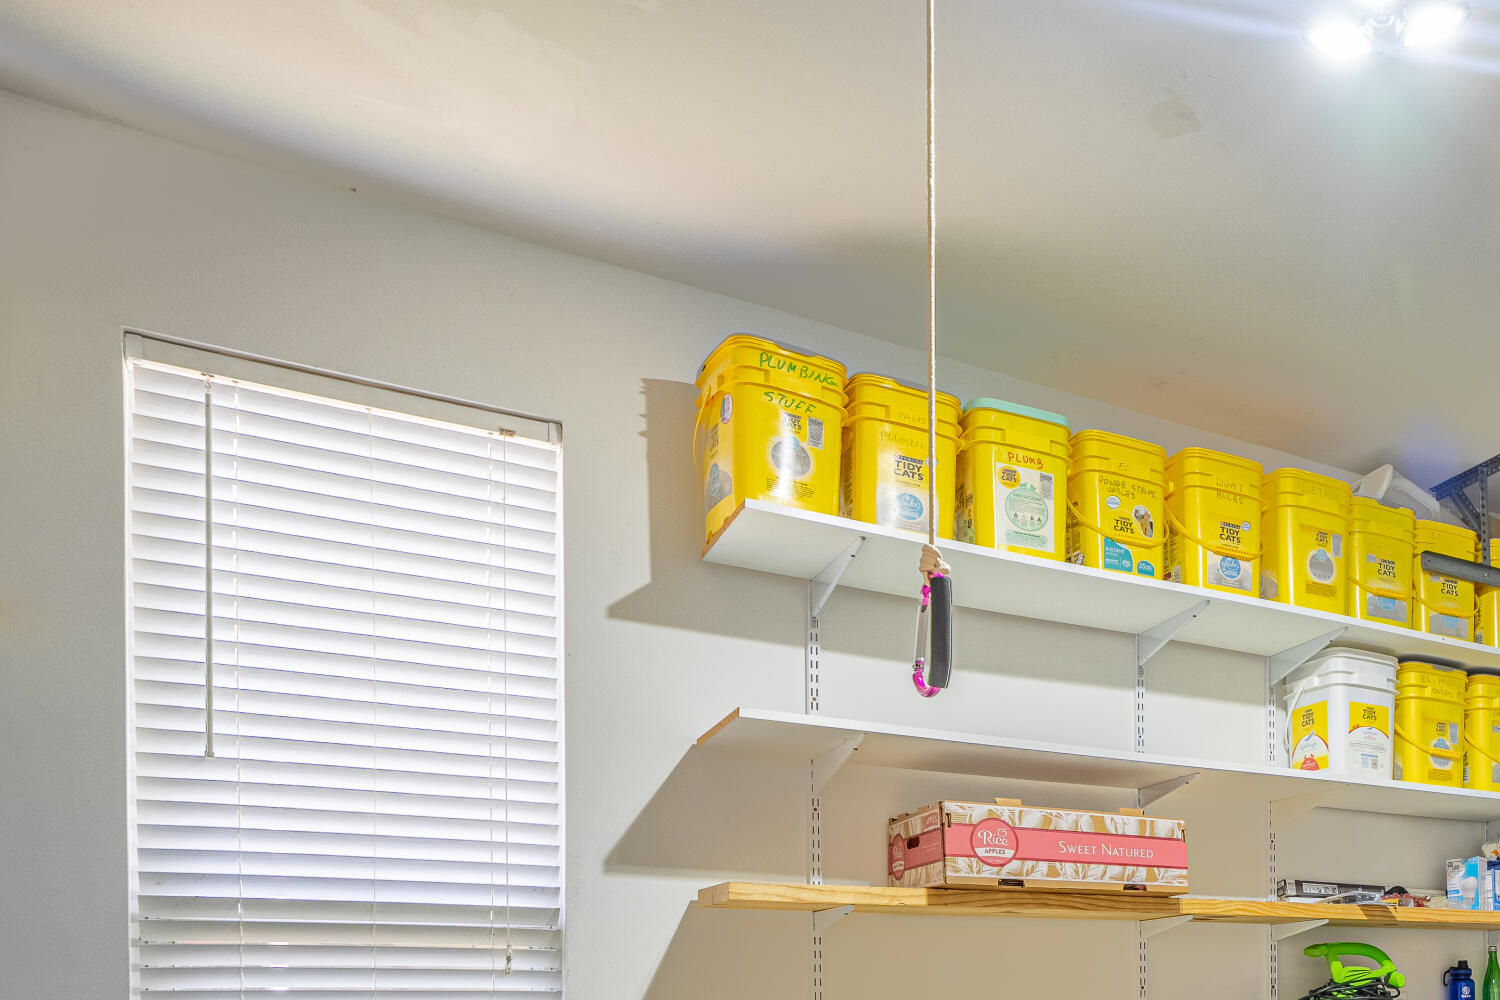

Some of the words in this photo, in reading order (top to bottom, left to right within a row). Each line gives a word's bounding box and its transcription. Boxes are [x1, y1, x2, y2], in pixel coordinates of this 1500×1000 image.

[760, 352, 838, 387] PLUMBING
[764, 391, 816, 413] STUFF
[1007, 451, 1044, 469] PLUMB
[895, 460, 923, 473] TIDY
[894, 468, 924, 481] CATS
[1001, 475, 1018, 483] CATS
[1002, 471, 1017, 479] TIDY
[1115, 519, 1133, 527] TIDY
[1113, 526, 1135, 535] CATS
[1220, 526, 1240, 536] TIDY
[1219, 533, 1241, 544] CATS
[1378, 563, 1395, 571] TIDY
[1377, 568, 1396, 578] CATS
[1442, 582, 1457, 590] TIDY
[1441, 588, 1459, 597] CATS
[1301, 718, 1315, 727] CATS
[977, 829, 1009, 846] Rice
[1058, 840, 1097, 855] SWEET
[1101, 843, 1154, 859] NATURED
